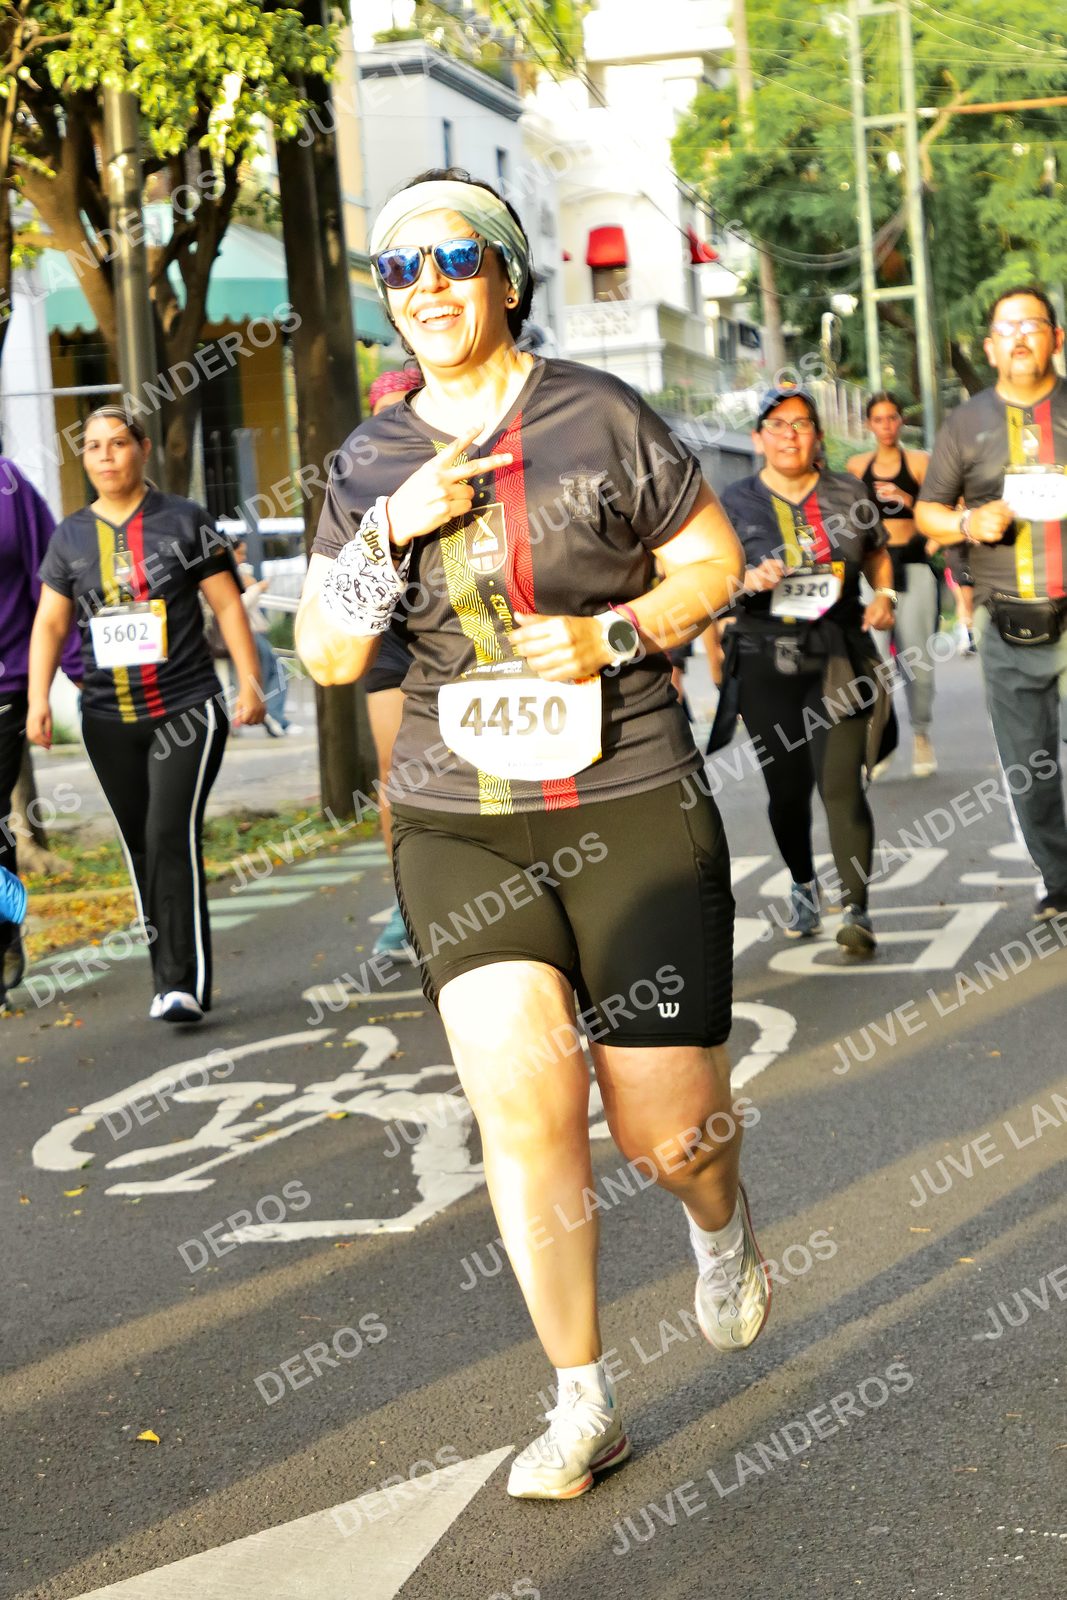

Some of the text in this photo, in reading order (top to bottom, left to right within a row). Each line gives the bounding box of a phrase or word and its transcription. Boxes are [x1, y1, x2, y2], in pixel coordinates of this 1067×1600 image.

[782, 582, 829, 598] 3320
[102, 622, 149, 644] 5602
[460, 695, 567, 737] 4450
